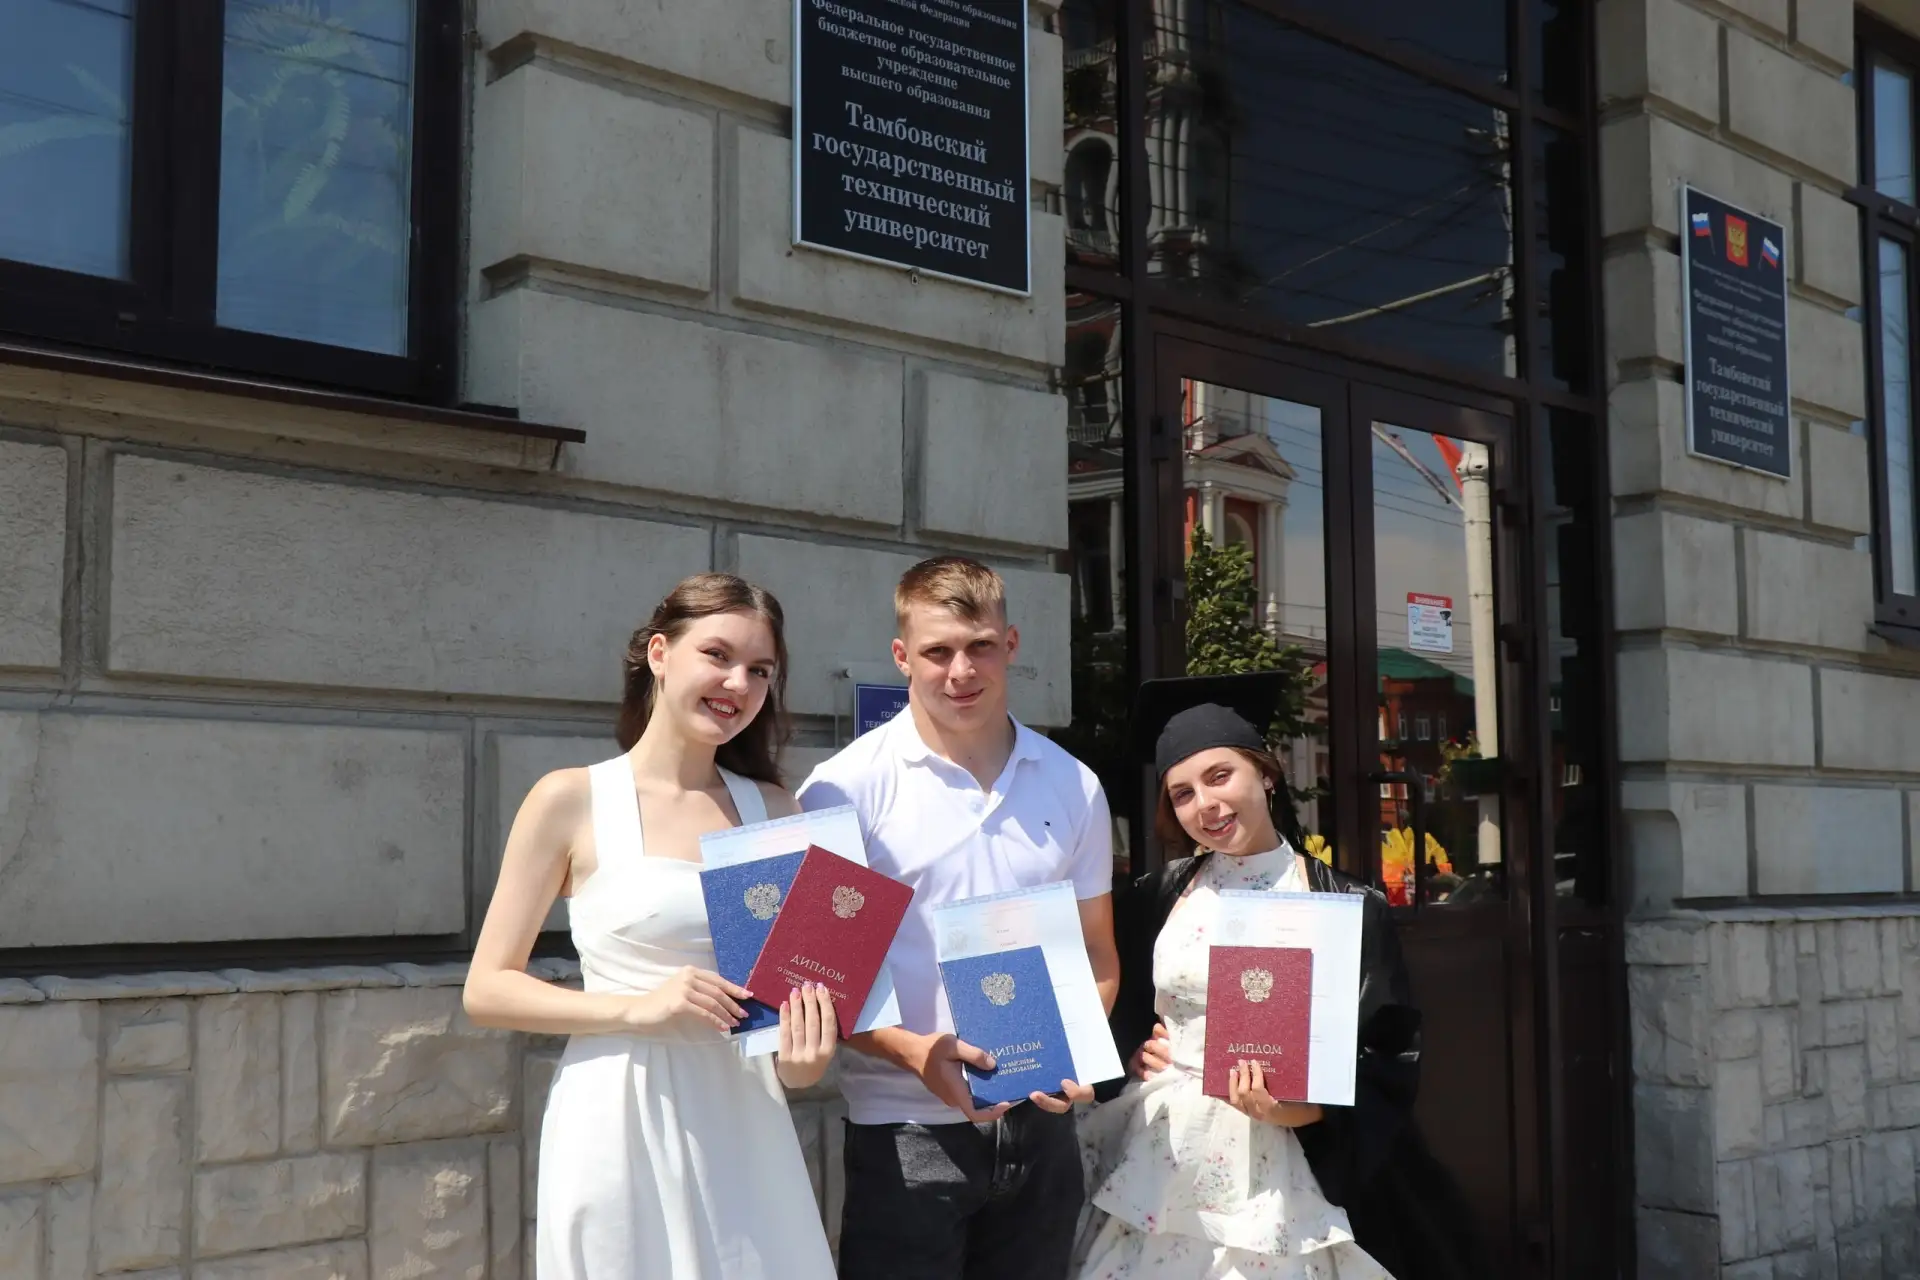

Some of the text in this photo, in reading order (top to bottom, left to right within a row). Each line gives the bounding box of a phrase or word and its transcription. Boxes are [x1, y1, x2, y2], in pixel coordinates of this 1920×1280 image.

[920, 3, 971, 28] Федерации
[962, 4, 1018, 30] образования
[811, 0, 1016, 72] Федеральное государственное
[817, 16, 1012, 89] бюджетное образовательное
[876, 54, 958, 90] учреждение
[841, 64, 991, 119] высшего образования
[845, 101, 987, 164] Тамбовский
[812, 132, 1016, 203] государственный
[841, 173, 991, 229] технический
[844, 208, 989, 260] университет
[1708, 356, 1772, 392] Тамбовский
[1696, 379, 1785, 417] государственный
[1708, 405, 1774, 435] технический
[1710, 428, 1775, 457] университет
[790, 954, 846, 983] ДИПЛОМ
[1227, 1042, 1282, 1055] ДИПЛОМ
